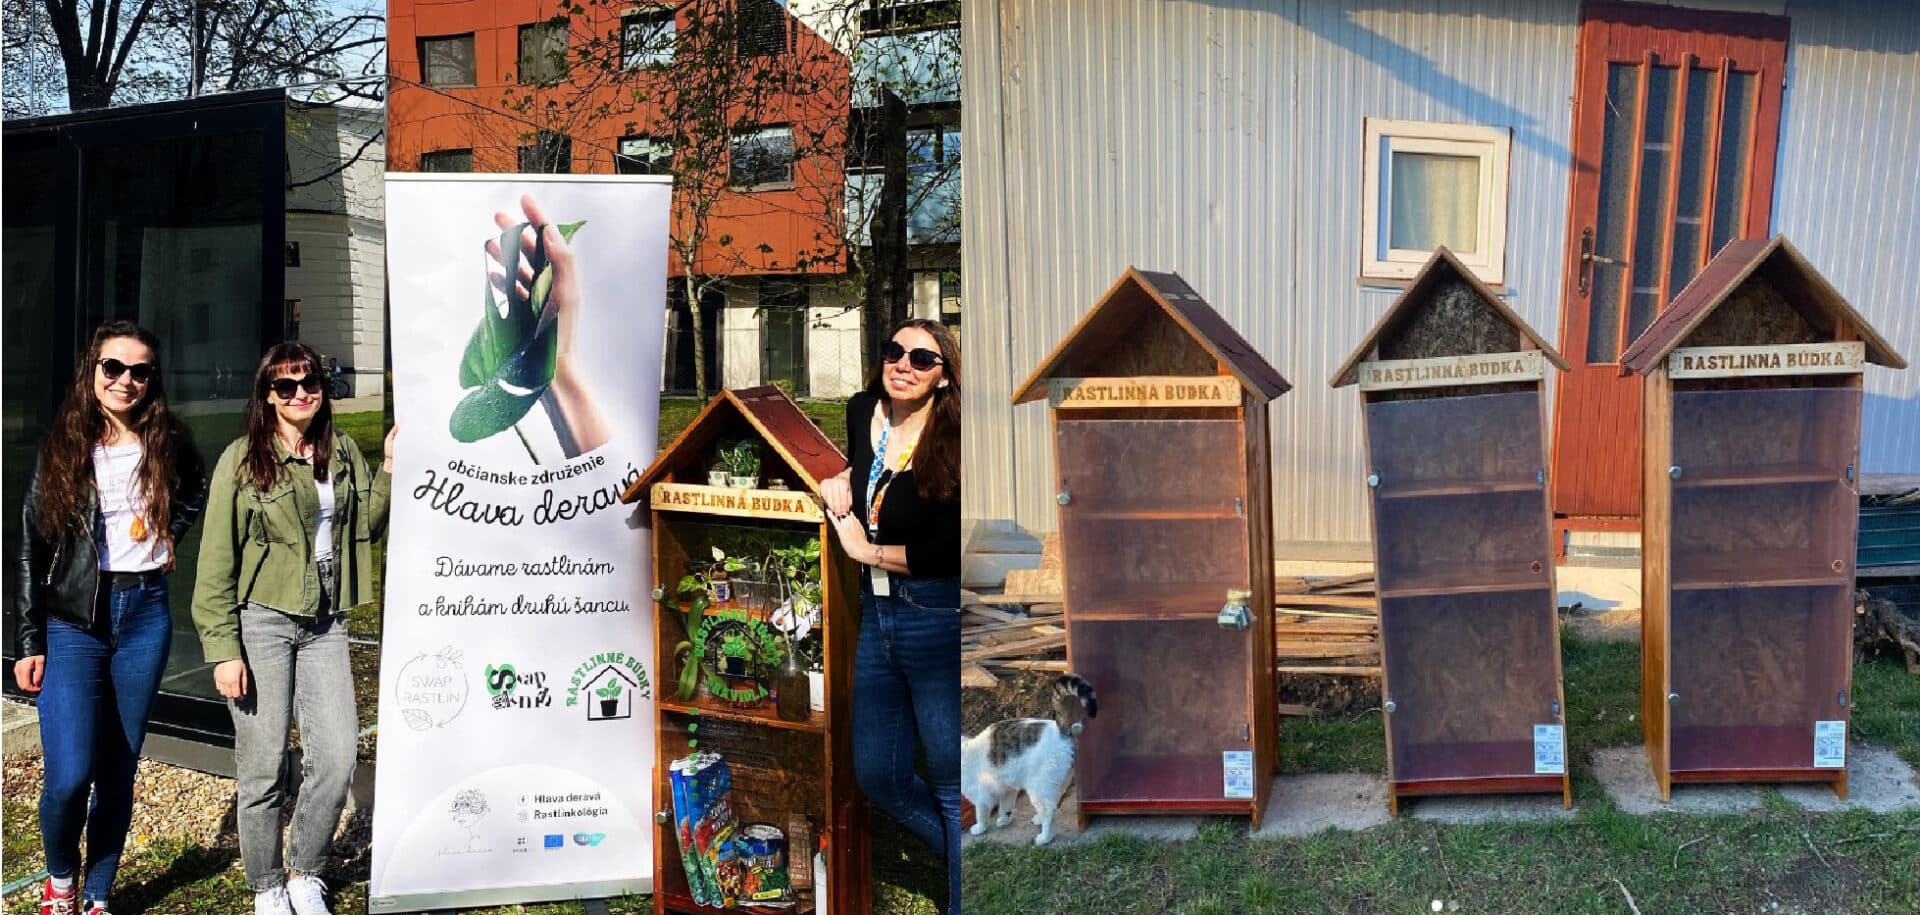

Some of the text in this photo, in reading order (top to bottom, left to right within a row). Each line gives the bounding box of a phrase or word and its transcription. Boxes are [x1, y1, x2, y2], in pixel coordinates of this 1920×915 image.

[448, 455, 605, 486] občianske združenie
[413, 470, 524, 526] Hlava
[434, 555, 614, 578] Dávame rastlinám
[418, 604, 433, 616] a
[435, 595, 507, 616] knihám
[511, 594, 570, 616] druhú
[534, 794, 564, 803] Hlava
